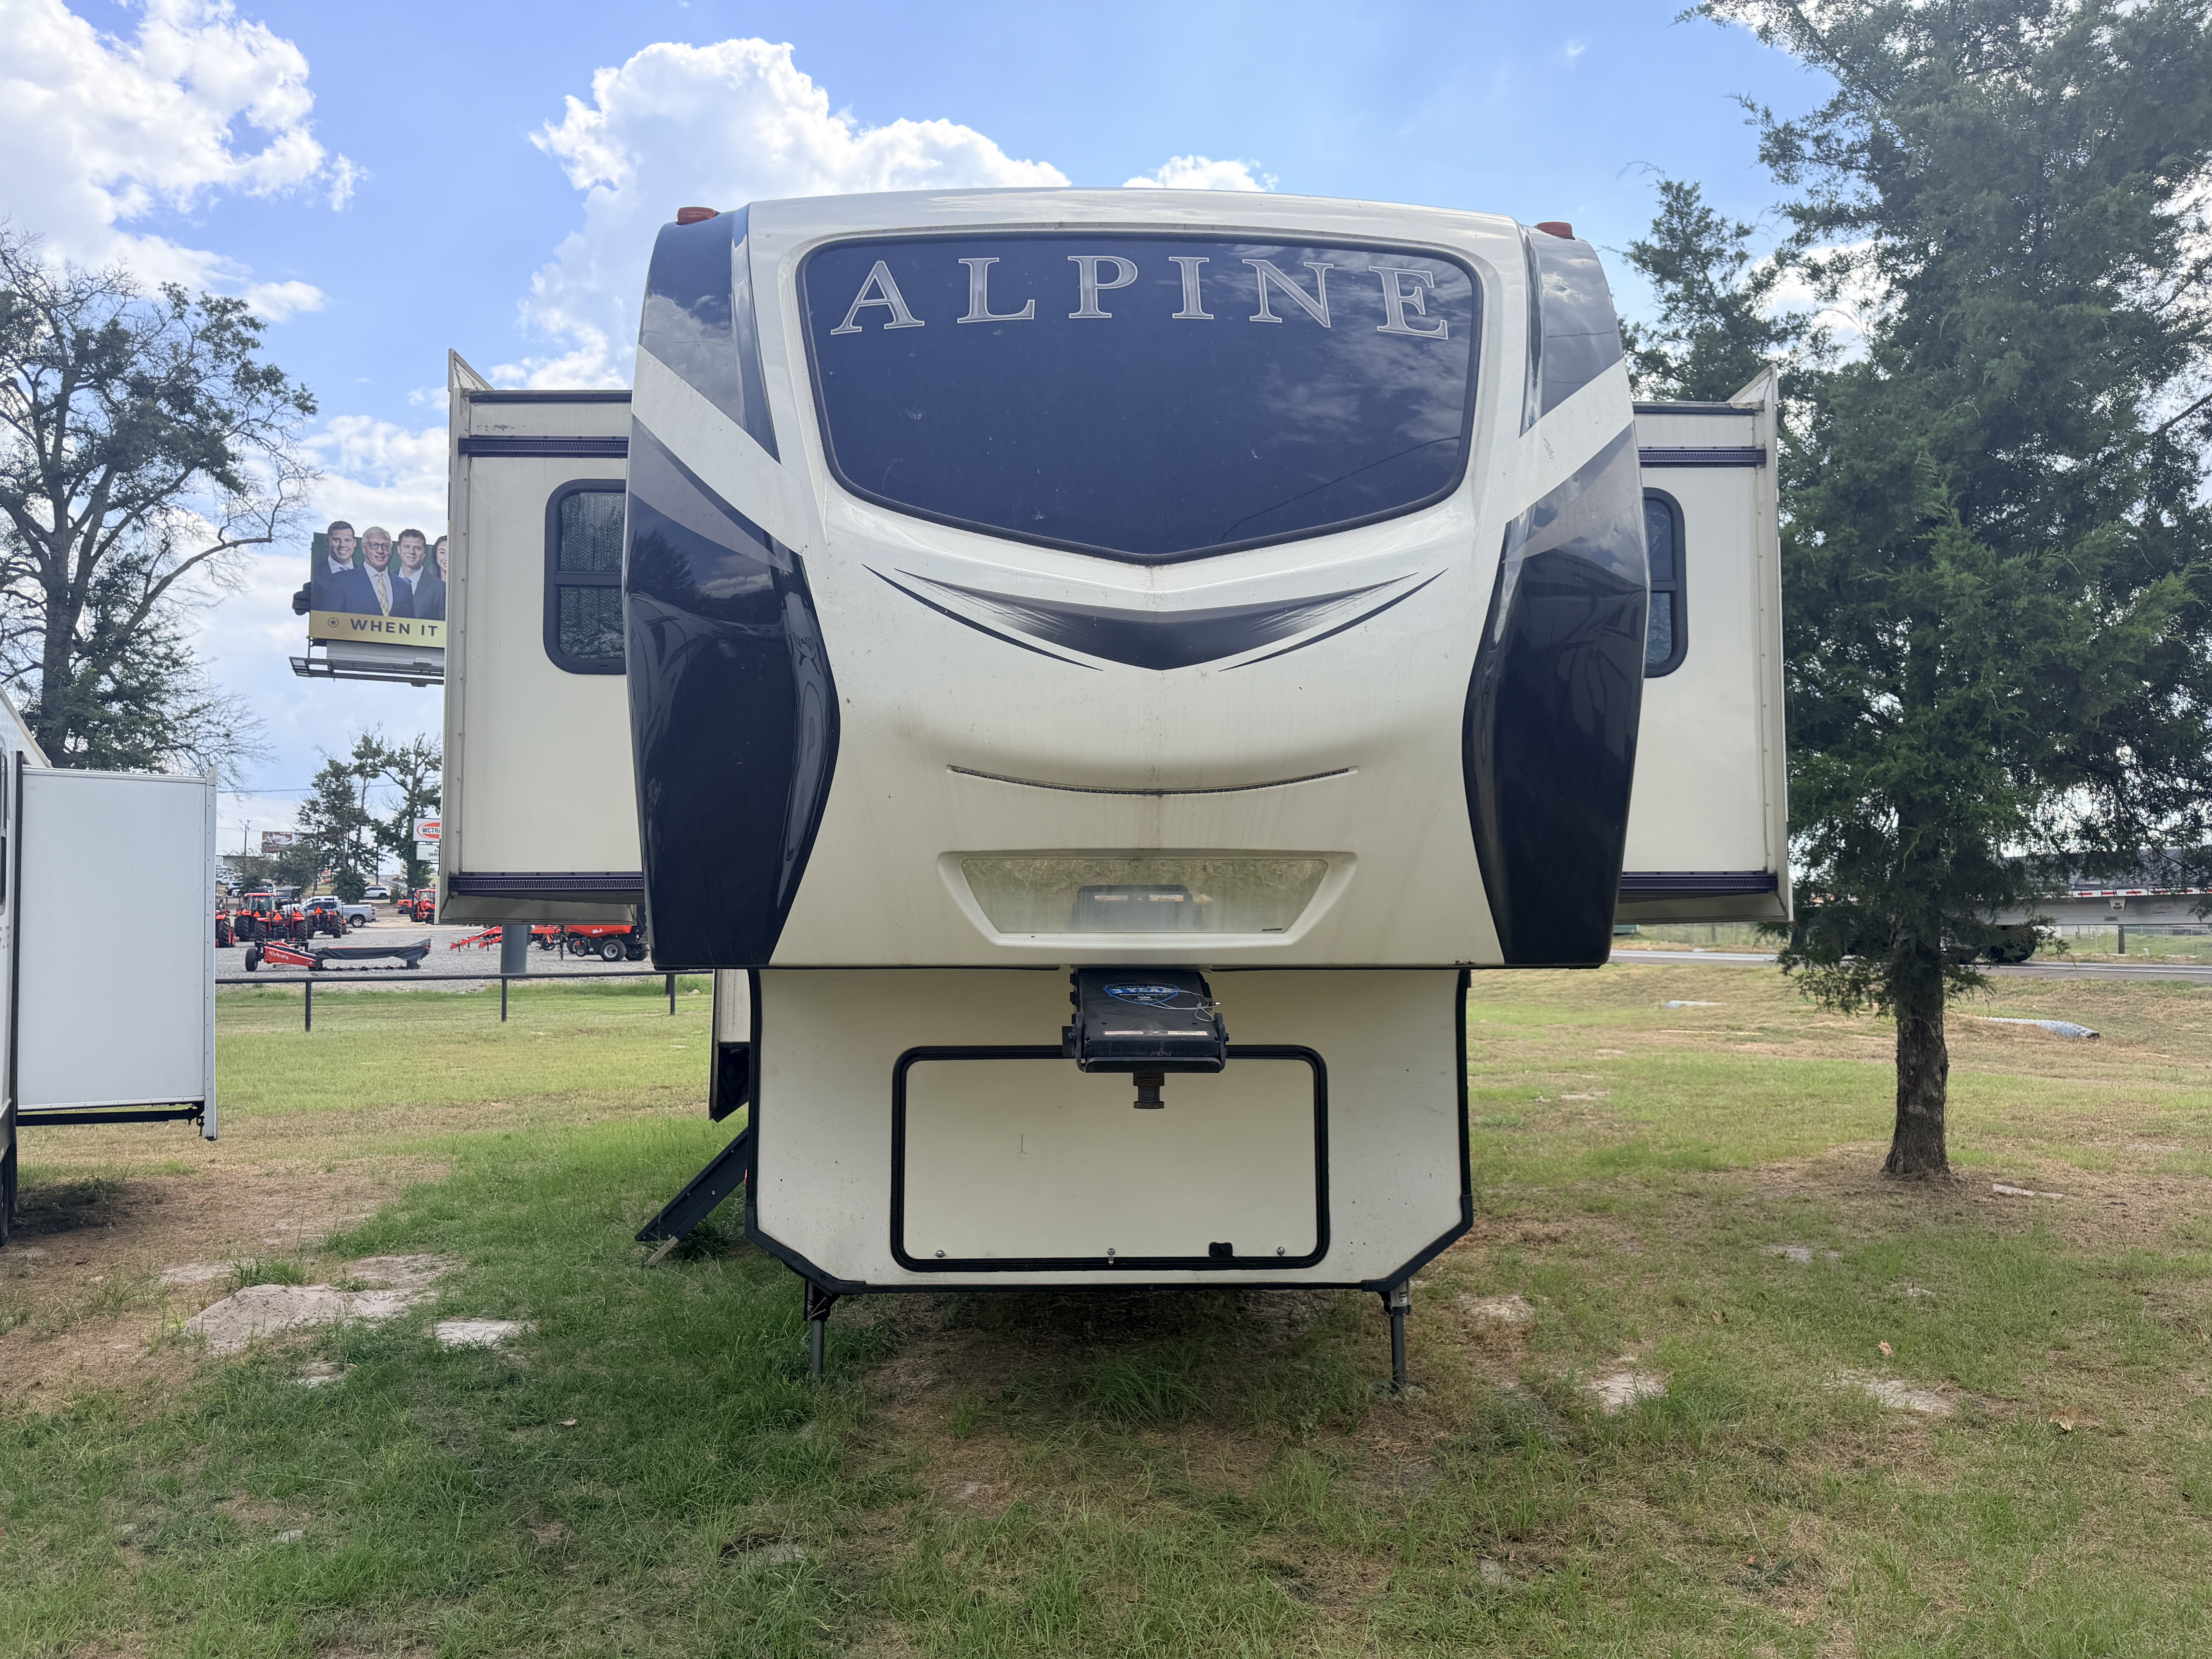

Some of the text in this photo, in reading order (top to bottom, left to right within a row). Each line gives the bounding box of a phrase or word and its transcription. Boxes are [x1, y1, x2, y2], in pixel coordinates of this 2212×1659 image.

[831, 255, 1448, 340] ALPINE
[350, 619, 437, 636] WHEN IT
[269, 951, 289, 959] Kubota
